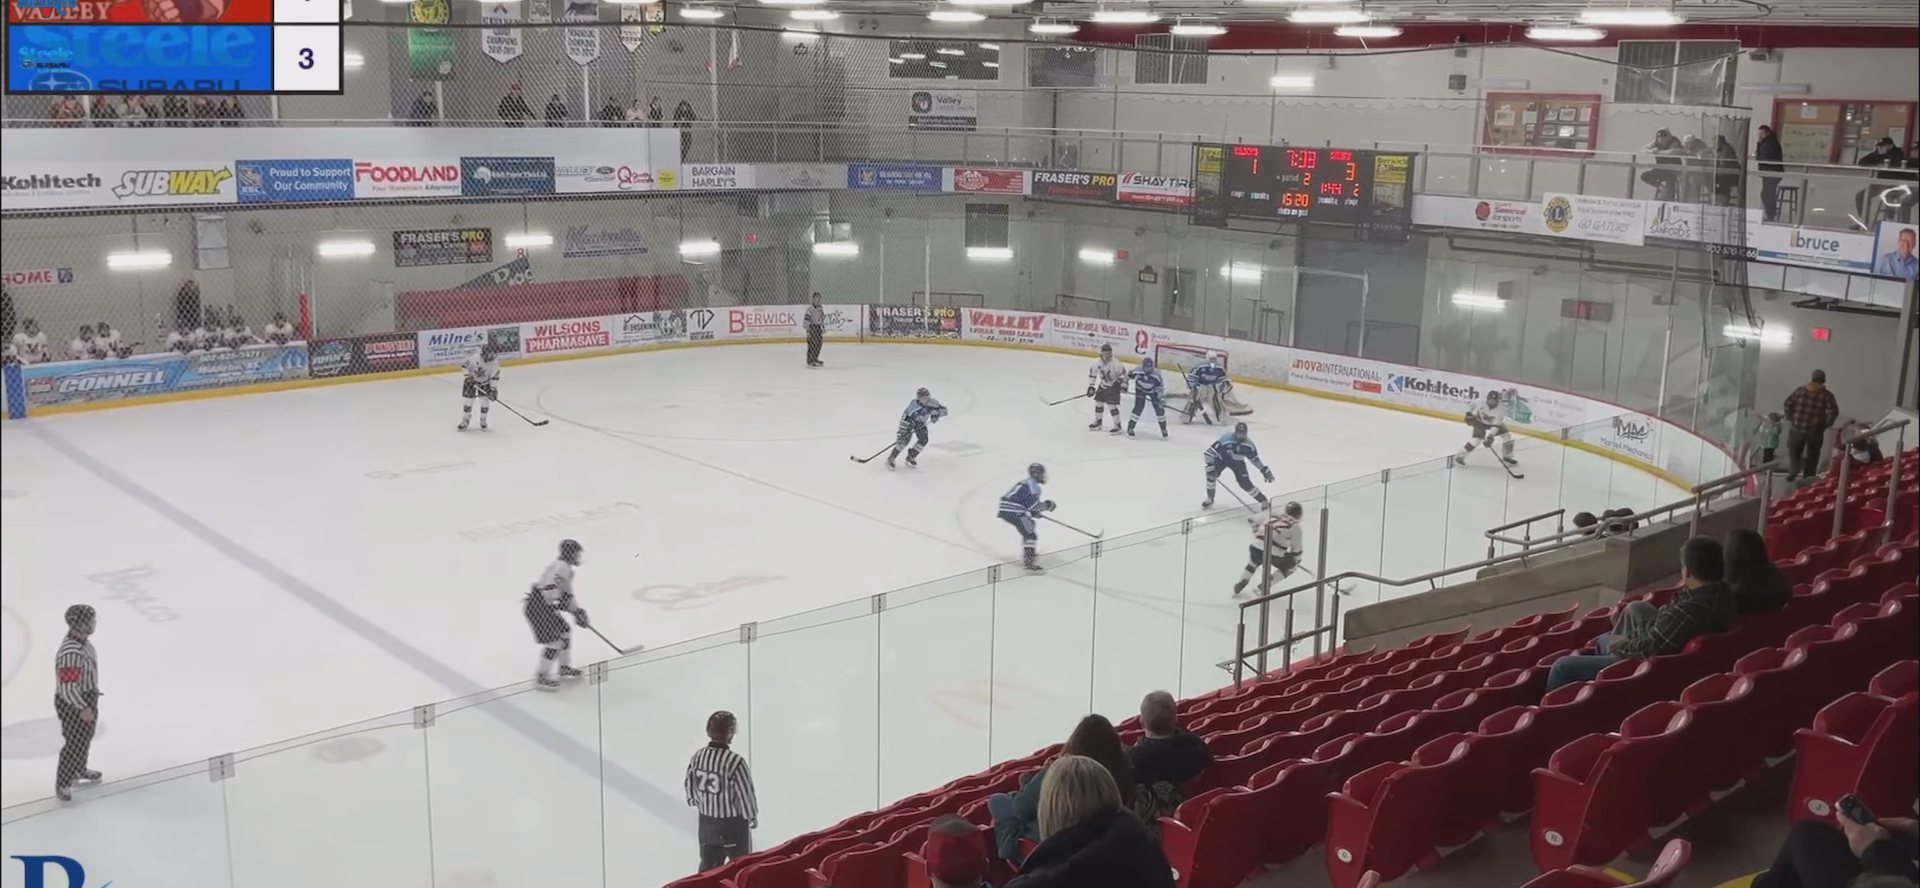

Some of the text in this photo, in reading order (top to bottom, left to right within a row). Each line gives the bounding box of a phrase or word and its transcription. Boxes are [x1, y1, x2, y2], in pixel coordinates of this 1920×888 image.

[269, 167, 350, 179] Proud to Support
[355, 162, 459, 183] FOODLAND
[692, 167, 736, 176] BARGAIN
[1034, 172, 1115, 186] FRASER'S PRO
[1303, 173, 1311, 185] 2
[1345, 163, 1355, 181] 3
[111, 166, 233, 199] SUBWAY
[274, 180, 349, 192] Our Community
[692, 178, 737, 187] HARLEY'S
[1133, 175, 1197, 188] SHAY TIRE
[1577, 218, 1631, 234] GO GATORS
[461, 230, 484, 241] PRO
[1796, 230, 1840, 252] bruce
[876, 306, 955, 318] FRASER'S PRO
[969, 309, 1046, 331] VALLEY
[534, 321, 601, 337] WILSONS
[729, 310, 796, 334] BERWICK
[428, 330, 485, 346] Milne's
[529, 333, 607, 351] PHARMASAVE
[59, 370, 166, 393] CONNELL
[1404, 376, 1480, 400] Kohltech
[696, 769, 720, 794] 73
